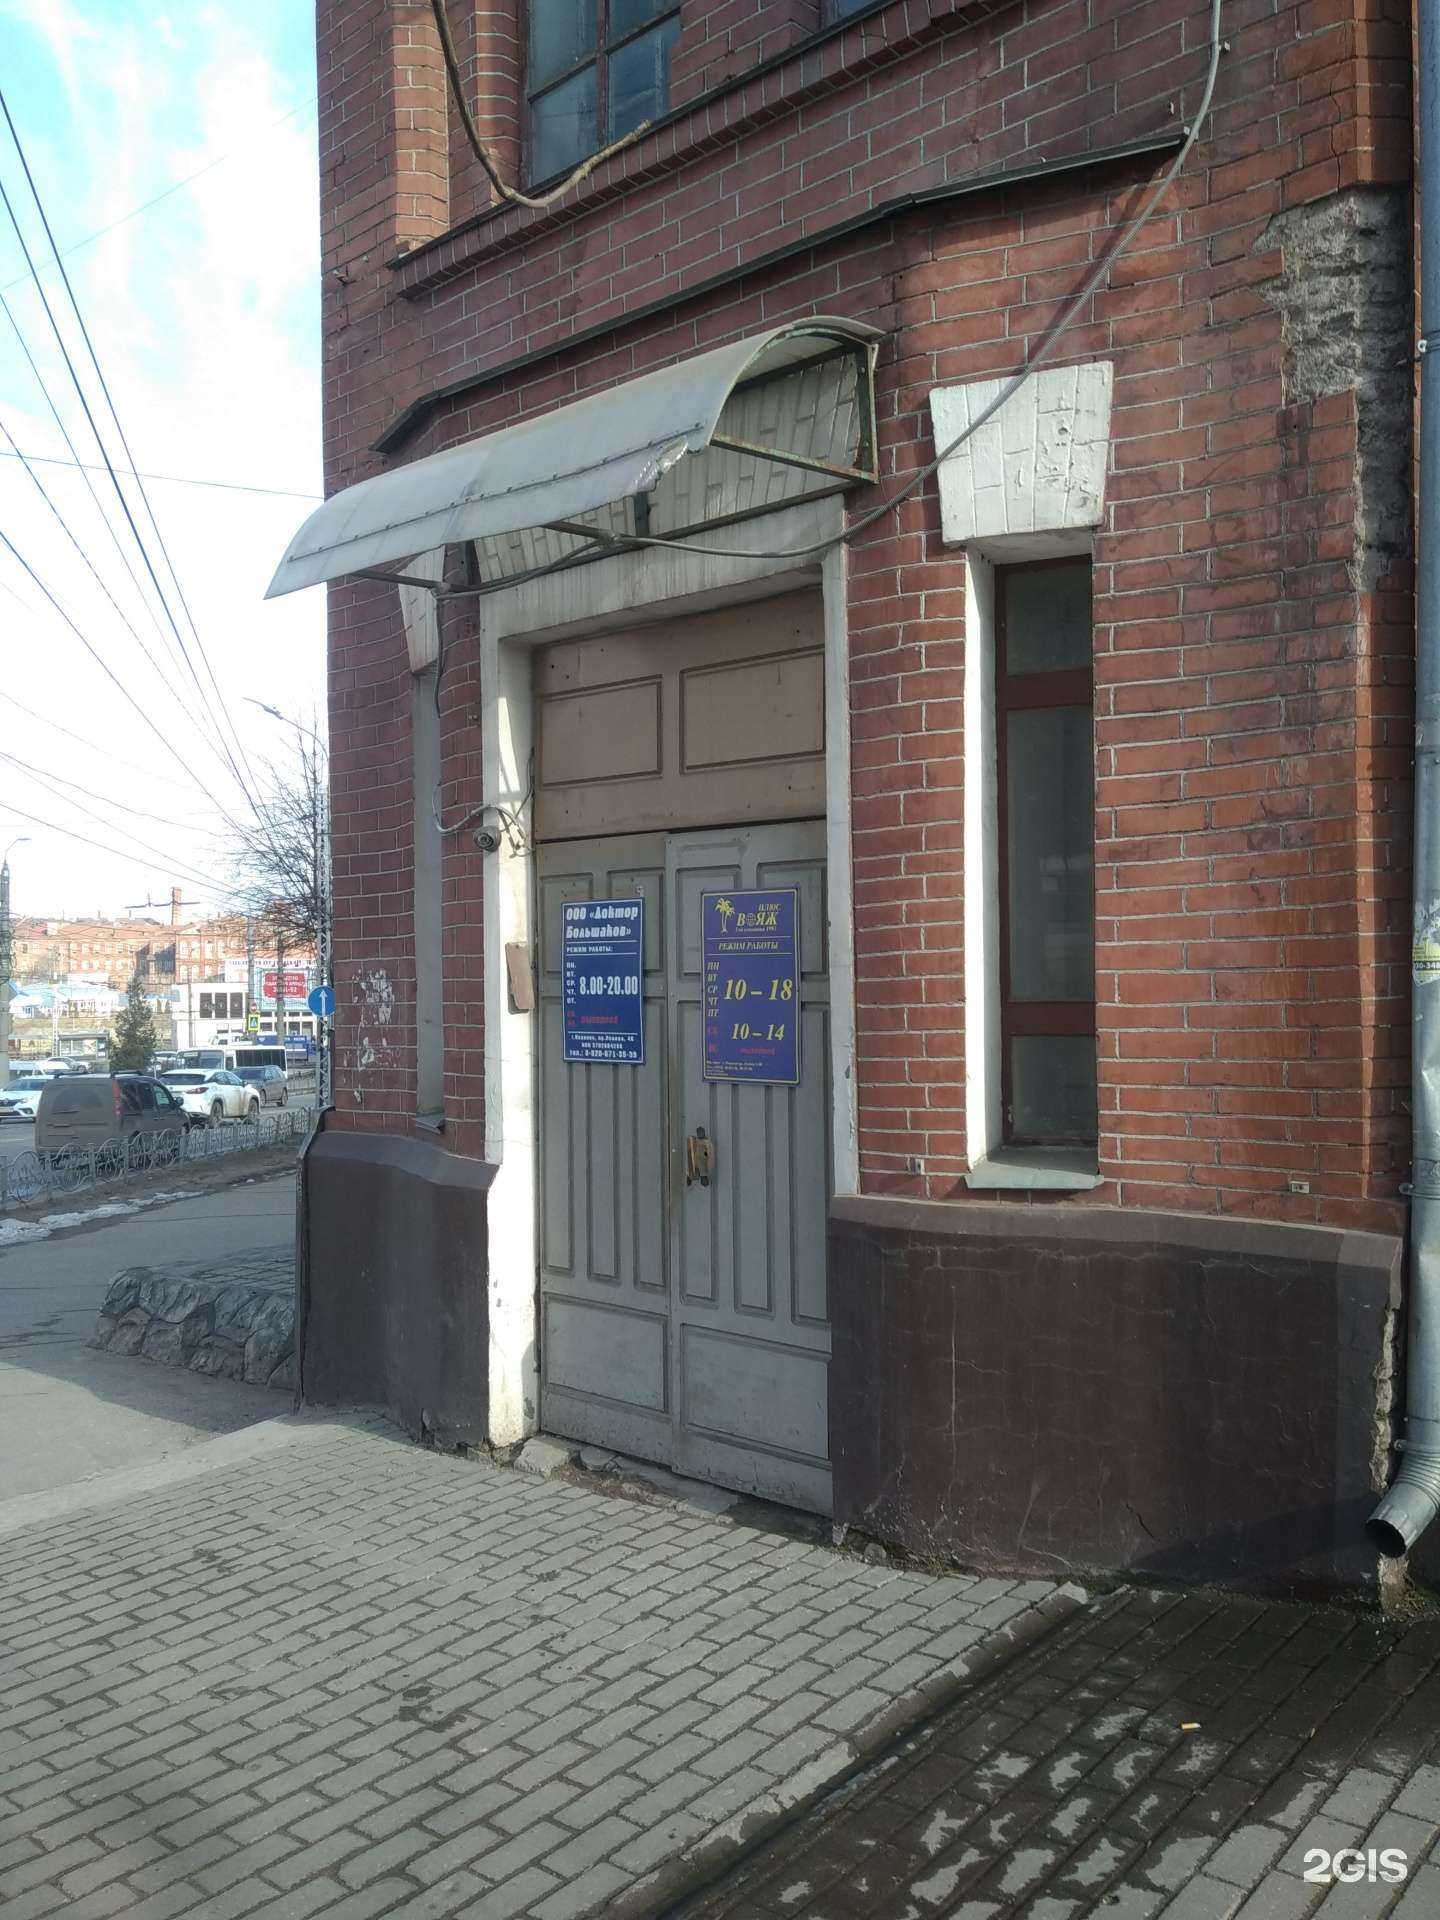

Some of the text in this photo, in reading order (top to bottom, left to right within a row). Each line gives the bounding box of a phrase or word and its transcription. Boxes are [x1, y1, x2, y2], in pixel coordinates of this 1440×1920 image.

[566, 907, 587, 920] ООО
[566, 924, 631, 938] Большаков»
[723, 978, 747, 1000] 10
[768, 978, 793, 1001] 18
[731, 1023, 750, 1040] 10
[766, 1023, 785, 1040] 14
